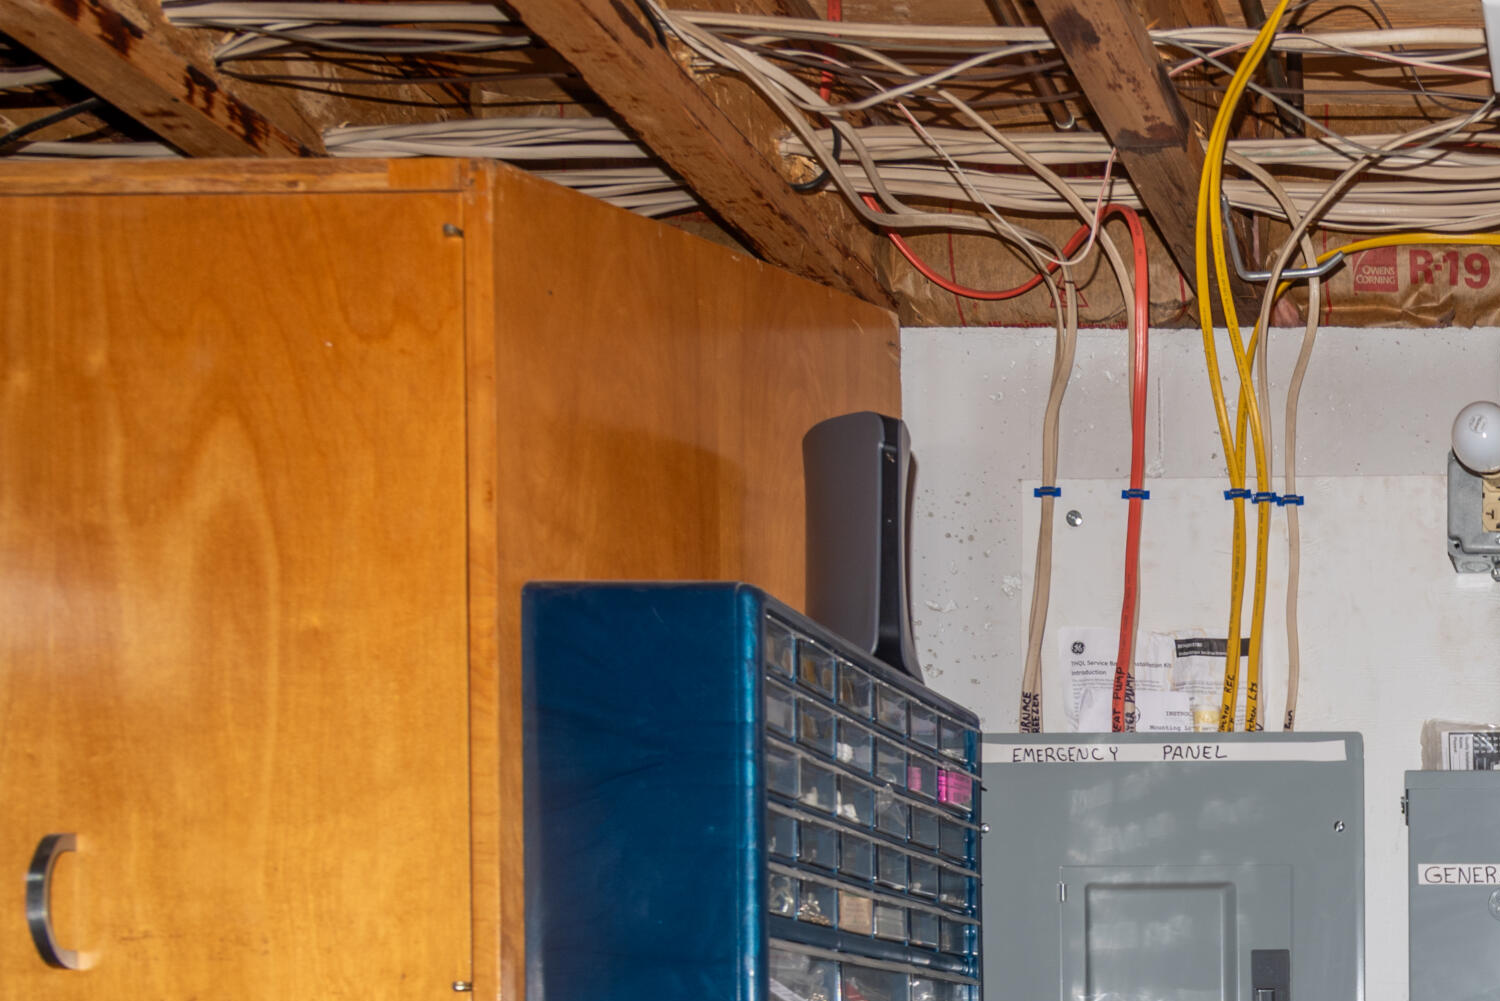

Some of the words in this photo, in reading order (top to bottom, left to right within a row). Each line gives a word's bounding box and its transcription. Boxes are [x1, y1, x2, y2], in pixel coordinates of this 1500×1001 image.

[1356, 274, 1395, 284] CORNING
[1362, 265, 1395, 275] OWENS
[1409, 249, 1491, 289] R-19
[1116, 666, 1126, 700] PUMP
[1021, 691, 1031, 733] URNACE
[1032, 693, 1040, 733] REEZER
[1112, 707, 1122, 733] EAT
[1012, 746, 1118, 762] EMERGENCY
[1162, 745, 1228, 761] PANEL
